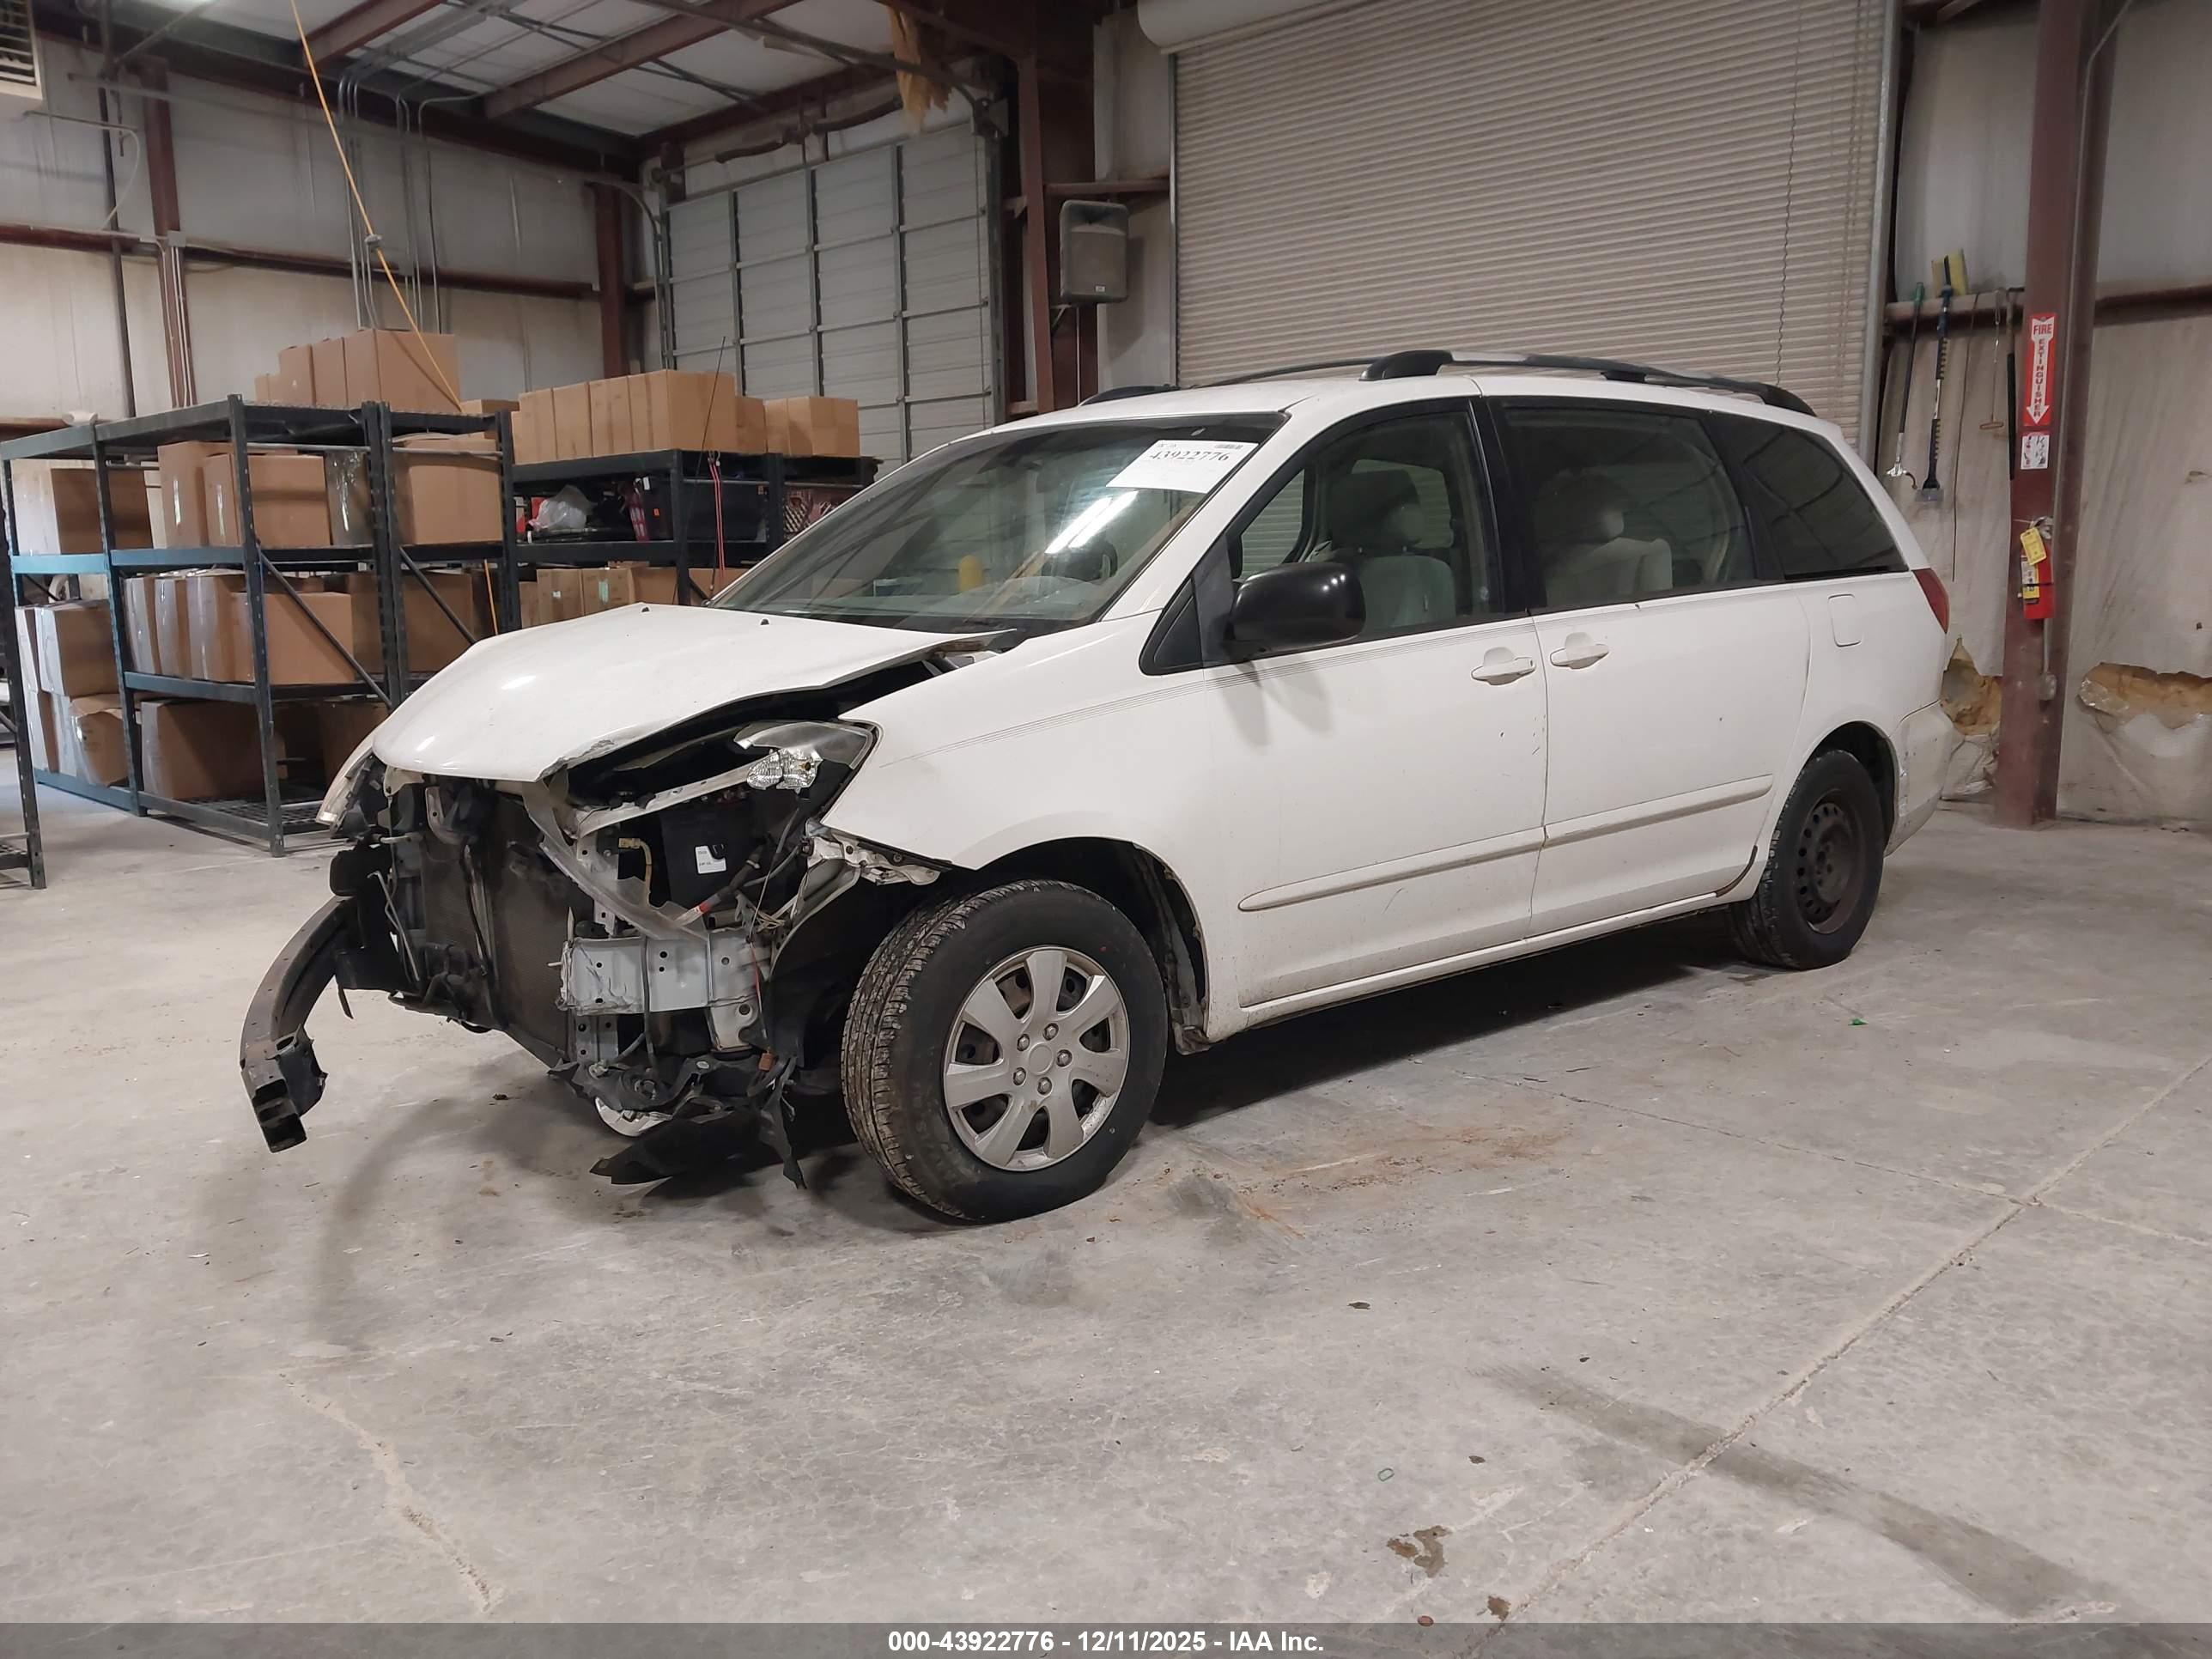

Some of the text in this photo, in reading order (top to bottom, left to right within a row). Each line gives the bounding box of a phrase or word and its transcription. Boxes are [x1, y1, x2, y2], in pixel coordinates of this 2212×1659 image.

[2033, 324, 2052, 336] FIRE
[2034, 338, 2044, 417] EXTINGUISHER
[1150, 450, 1231, 461] 43922776
